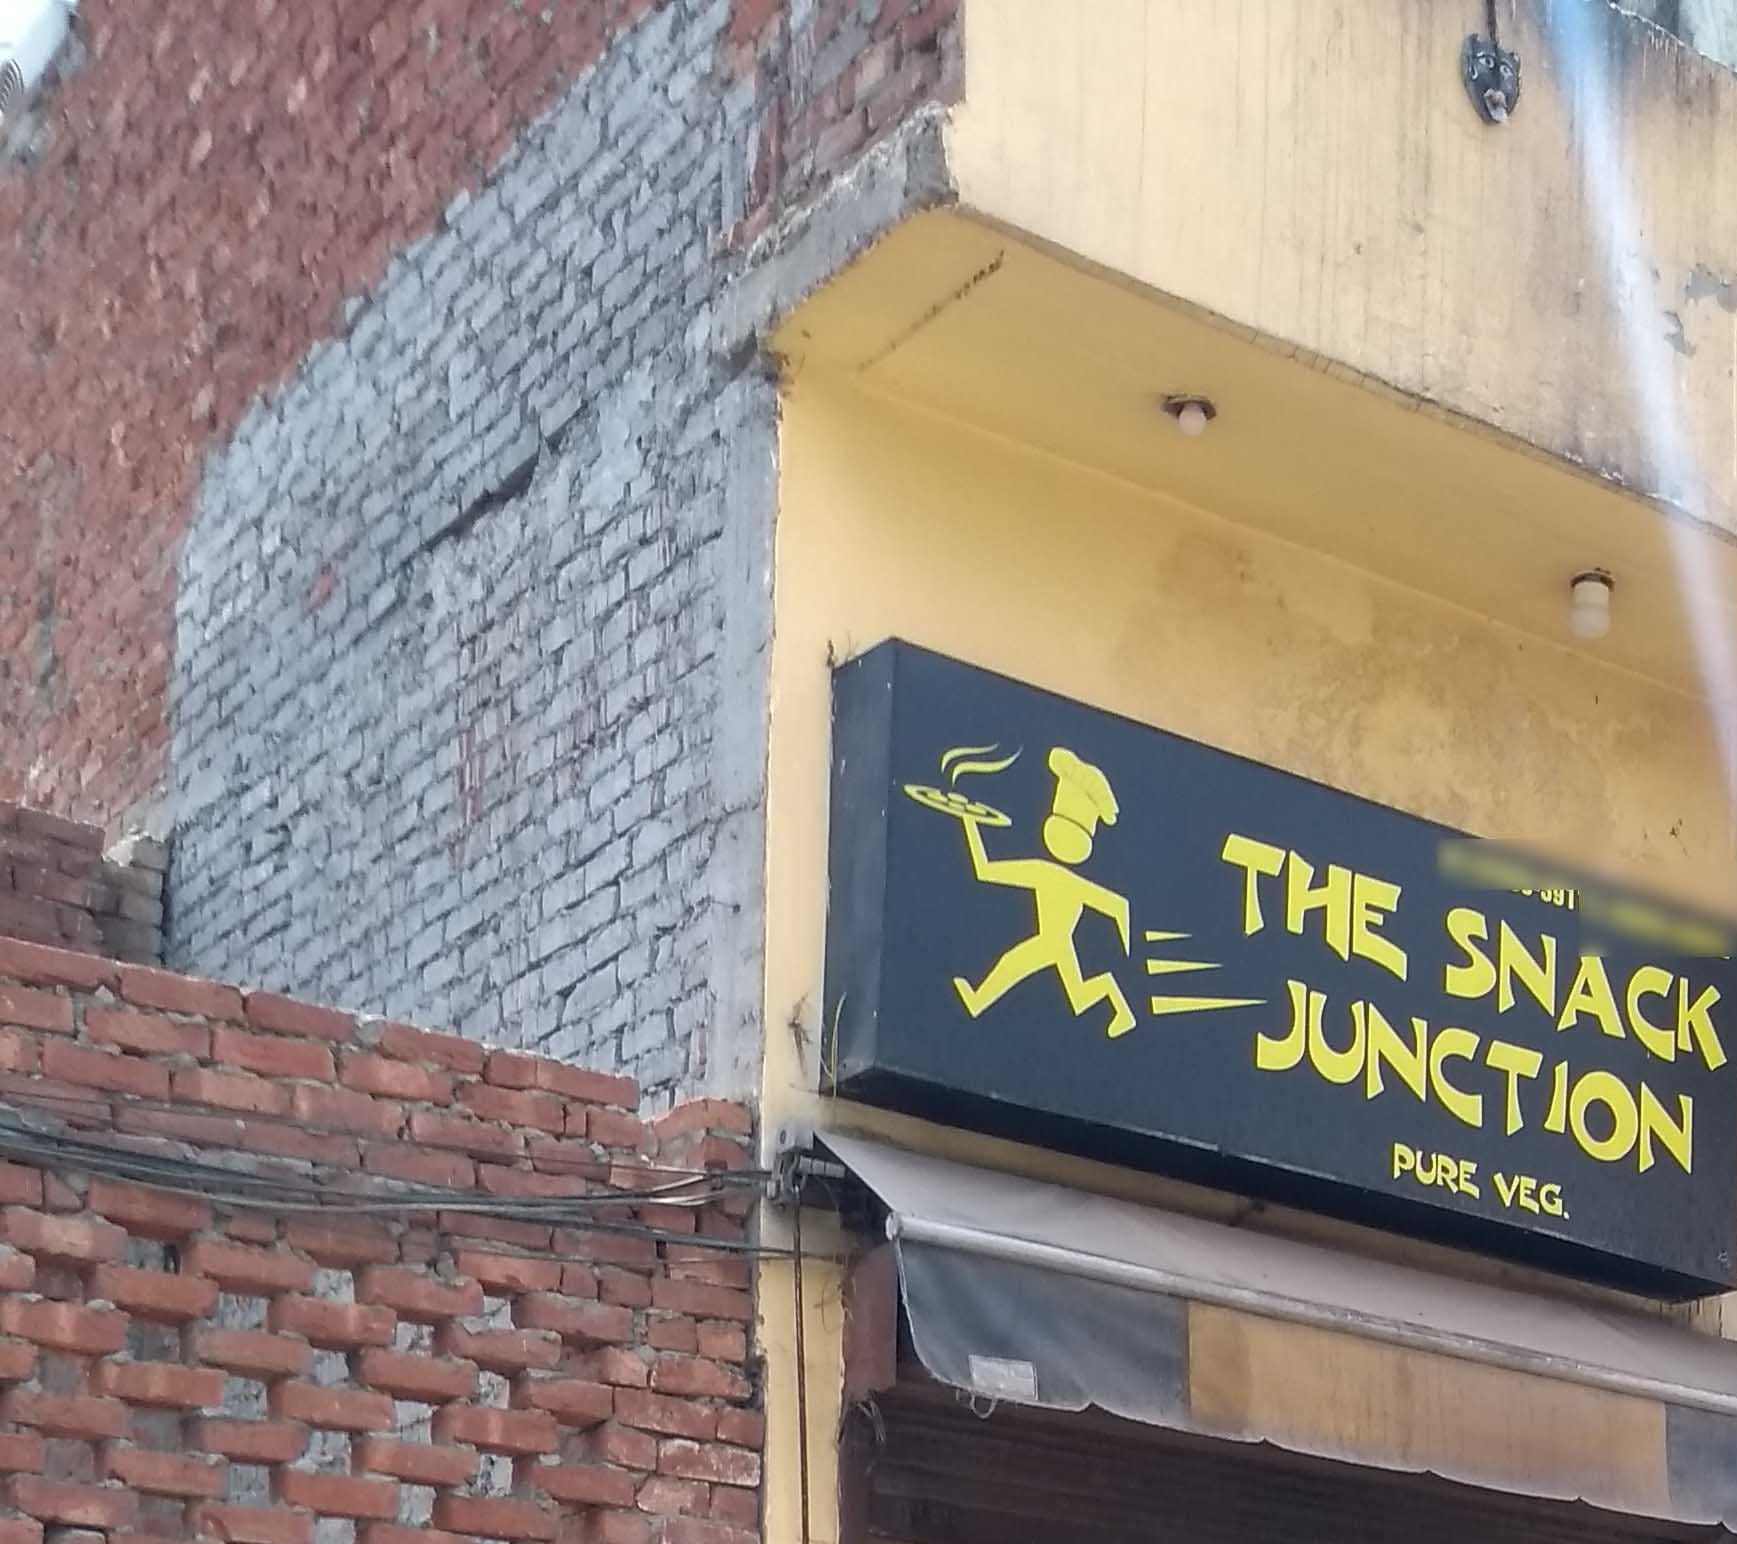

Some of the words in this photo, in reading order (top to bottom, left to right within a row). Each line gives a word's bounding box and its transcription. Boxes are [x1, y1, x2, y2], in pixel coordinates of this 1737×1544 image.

[1220, 833, 1407, 981] THE
[1444, 906, 1728, 1070] SNACK
[1255, 980, 1694, 1174] JUNCTION
[1393, 1142, 1480, 1200] PURE
[1493, 1172, 1570, 1220] VEG.
